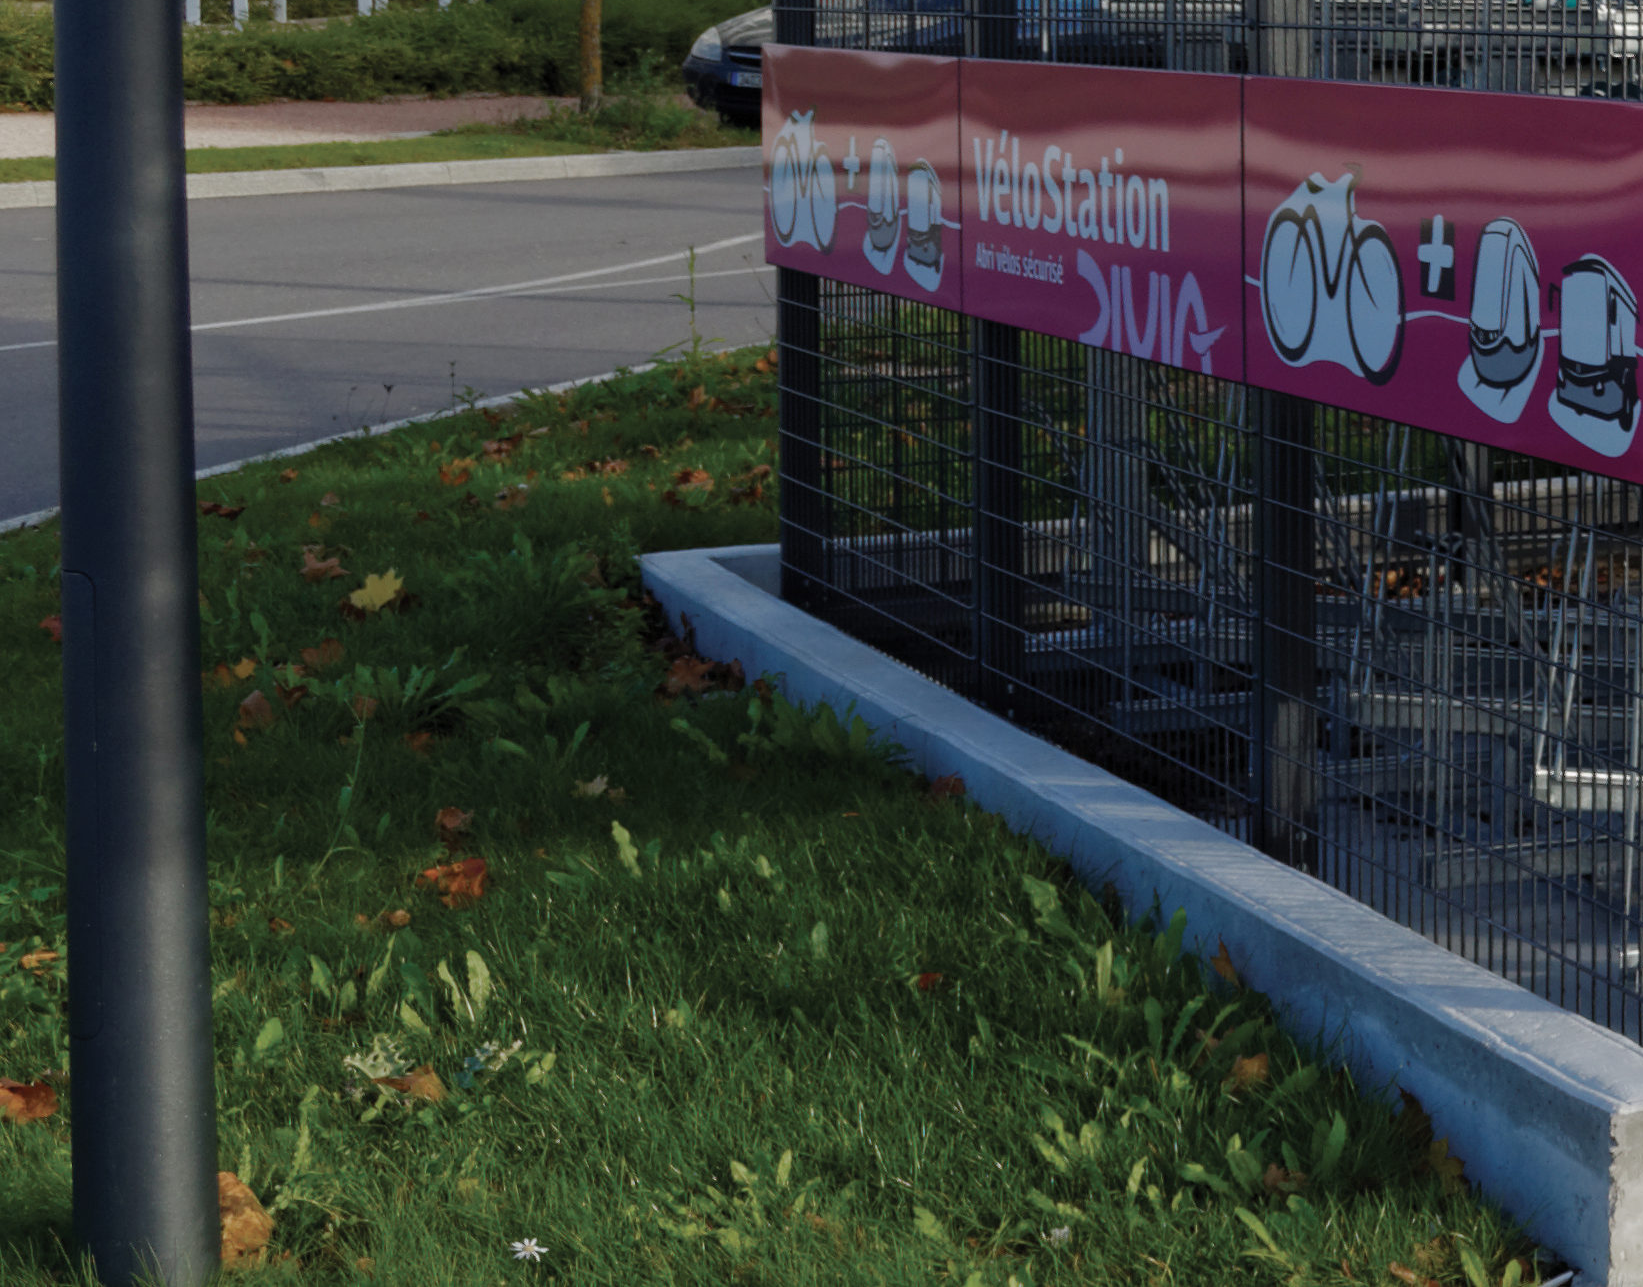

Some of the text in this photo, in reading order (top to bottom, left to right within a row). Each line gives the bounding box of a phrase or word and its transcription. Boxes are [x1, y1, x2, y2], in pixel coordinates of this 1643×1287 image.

[972, 129, 1170, 253] VéloStation
[975, 241, 1065, 286] Abri vélos sécurisé
